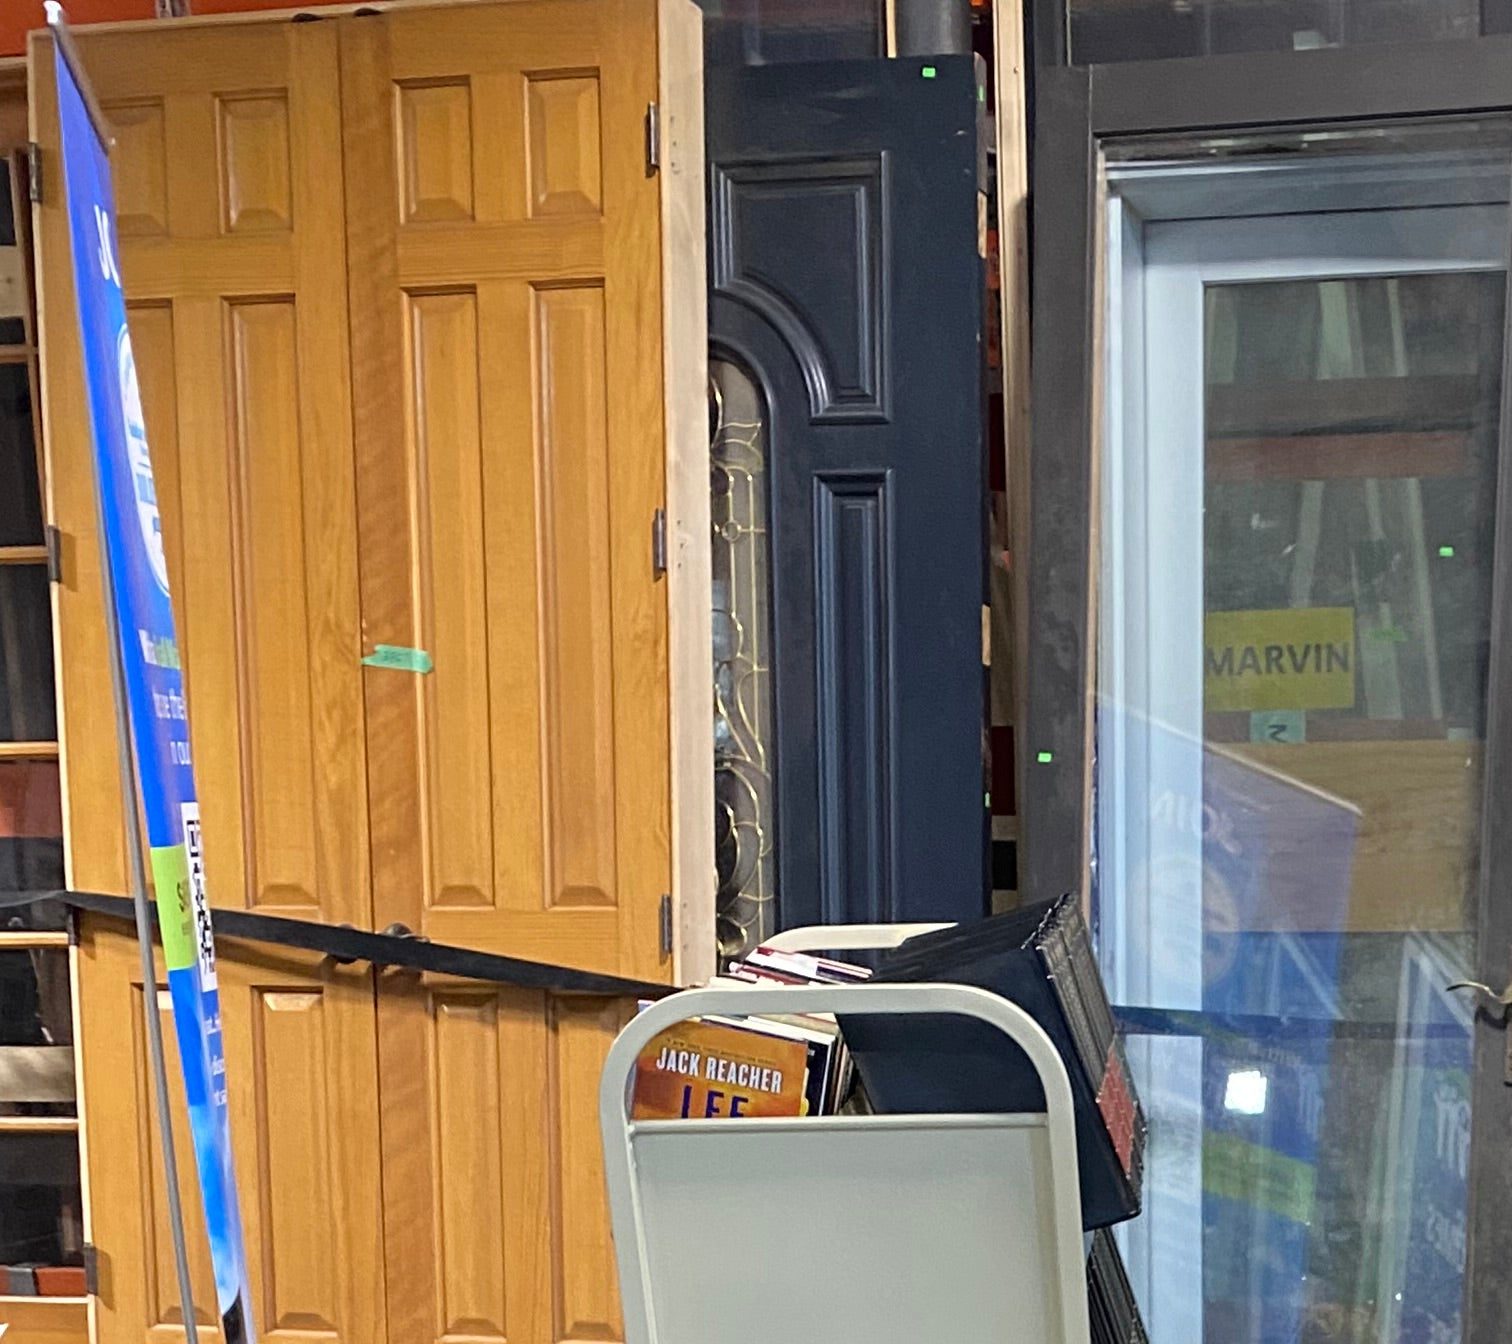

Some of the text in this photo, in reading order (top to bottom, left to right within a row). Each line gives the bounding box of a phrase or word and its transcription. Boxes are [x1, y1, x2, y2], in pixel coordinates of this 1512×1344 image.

[1206, 642, 1350, 677] MARVIN
[655, 1046, 701, 1078] JACK
[705, 1056, 783, 1094] REACHER
